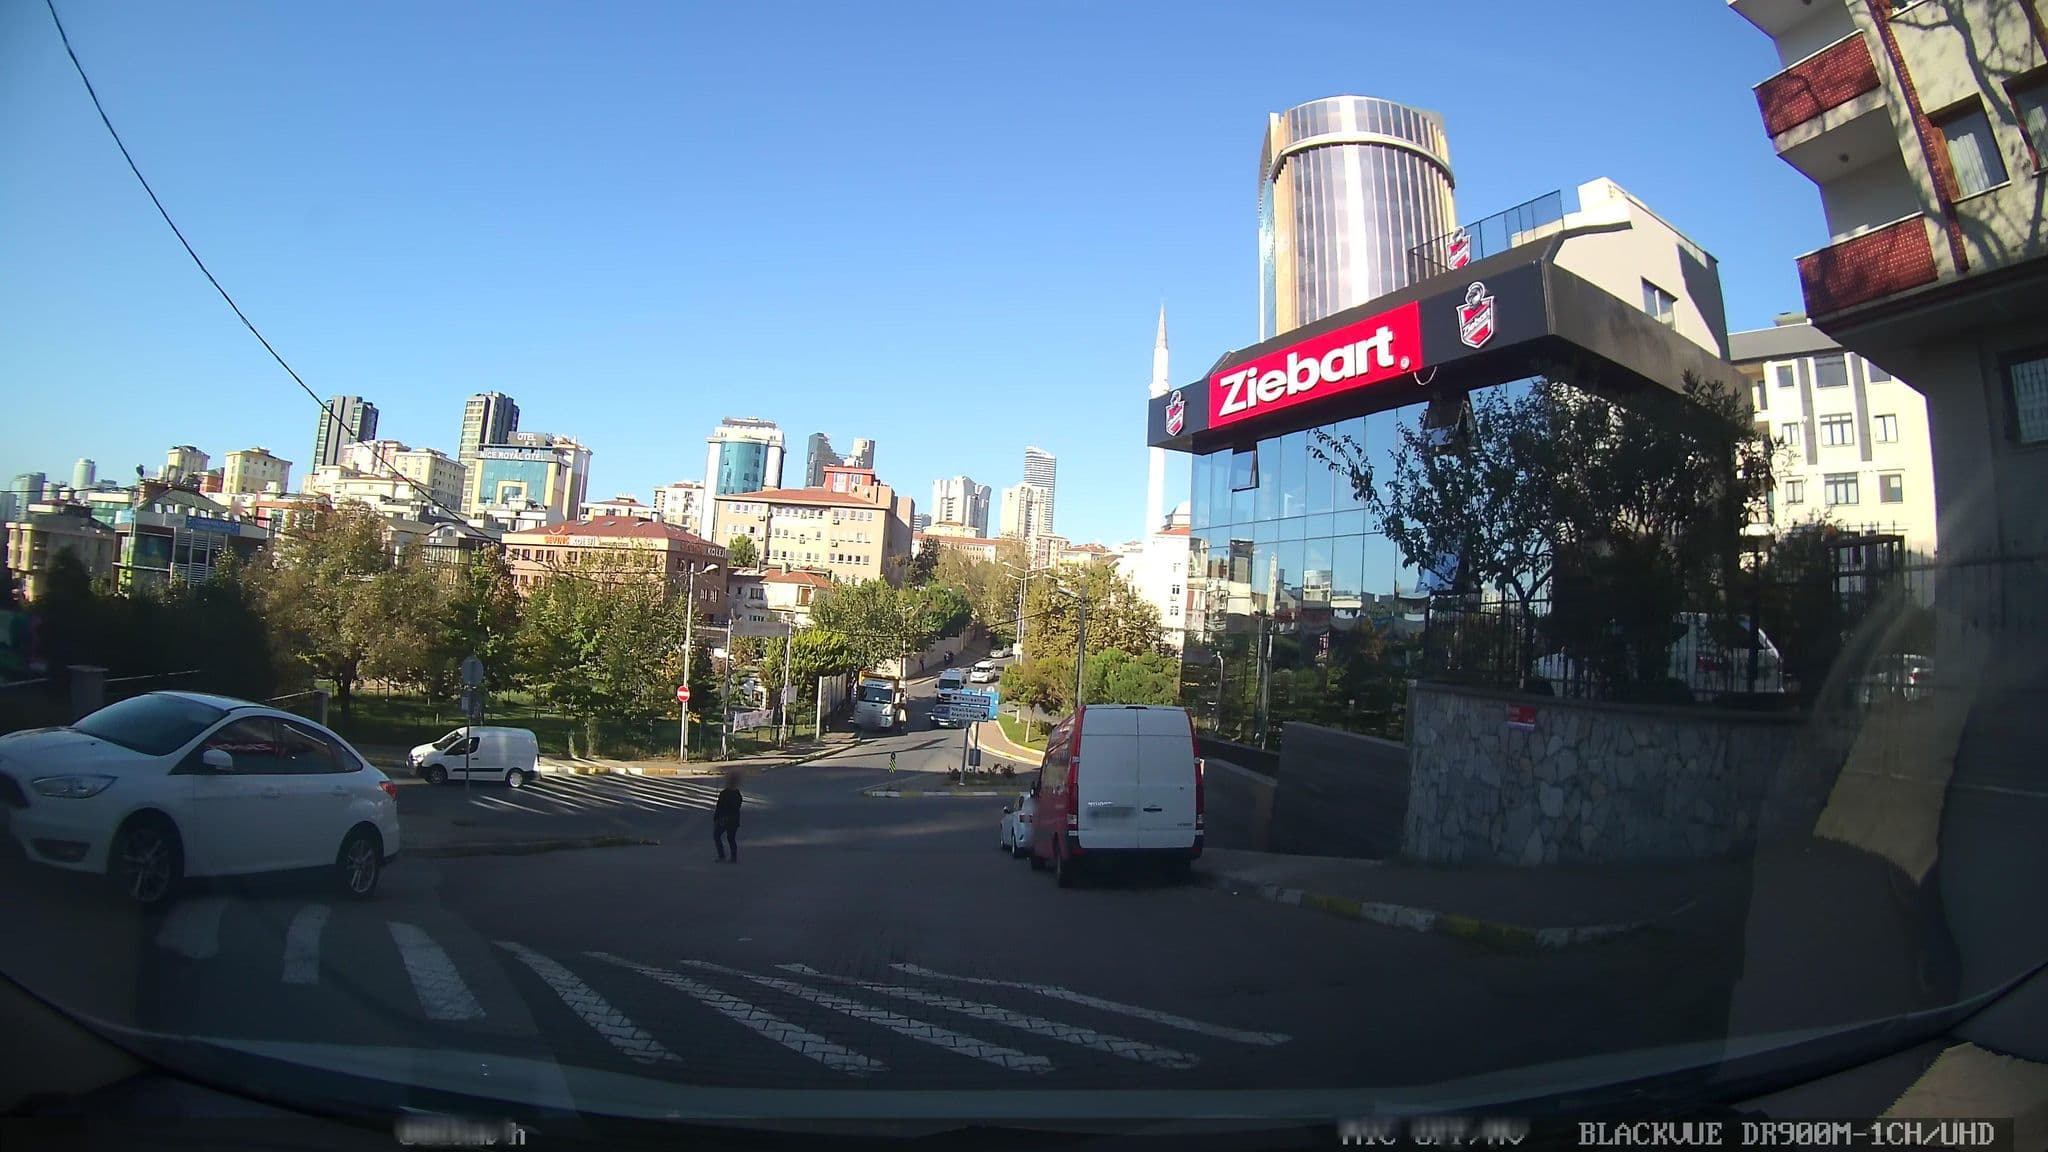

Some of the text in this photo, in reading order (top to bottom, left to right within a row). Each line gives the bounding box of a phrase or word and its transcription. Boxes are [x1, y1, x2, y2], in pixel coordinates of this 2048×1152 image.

[1218, 325, 1395, 417] Ziebart
[517, 433, 536, 441] OTEL
[498, 451, 523, 460] ROYAL
[524, 452, 546, 461] OTEL
